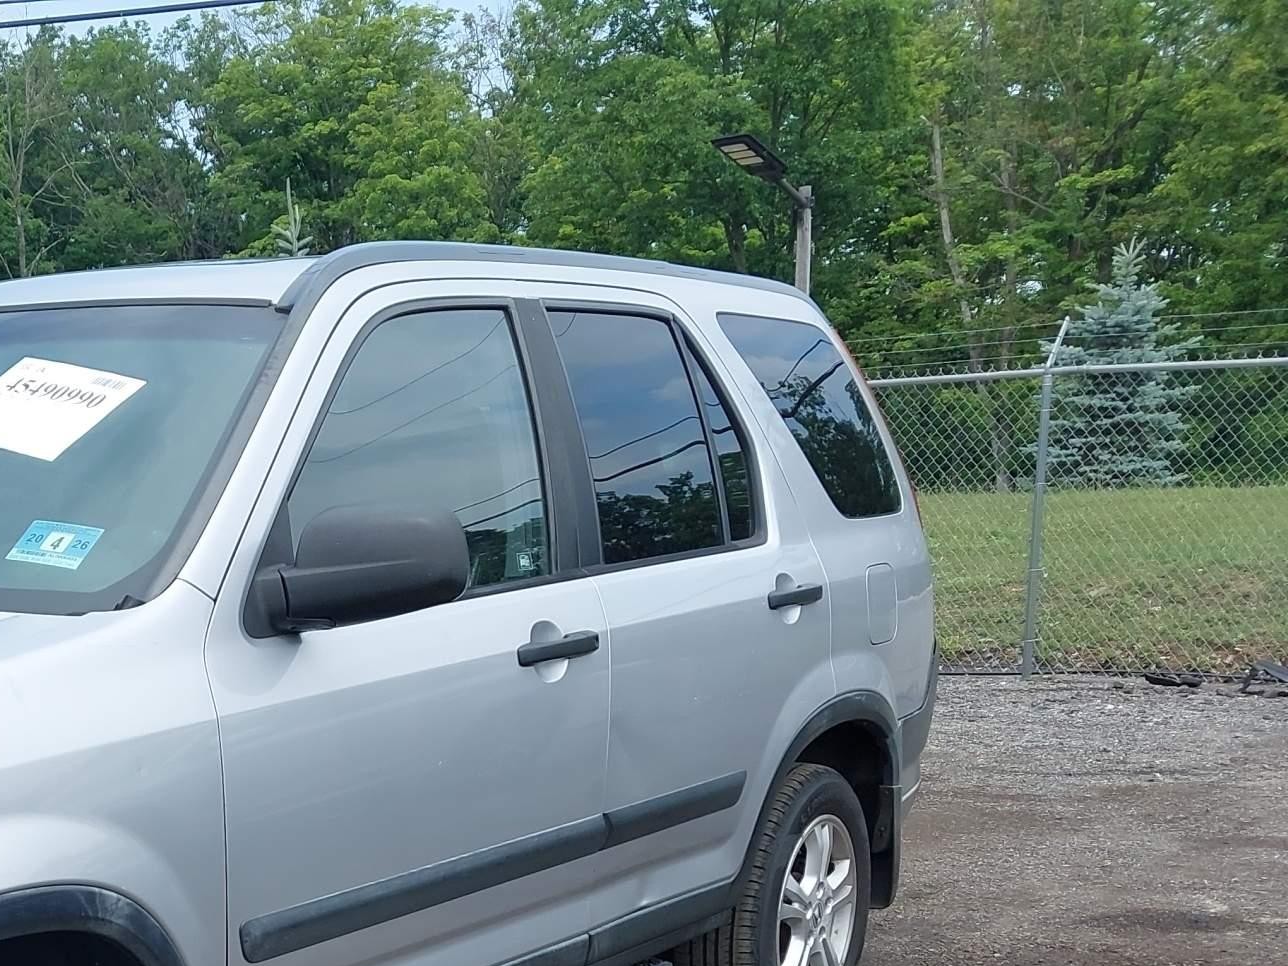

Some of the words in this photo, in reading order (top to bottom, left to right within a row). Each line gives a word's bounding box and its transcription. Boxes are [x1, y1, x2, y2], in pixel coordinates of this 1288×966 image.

[5, 378, 106, 408] 45490990
[26, 533, 44, 543] 20
[50, 536, 65, 550] 4
[72, 539, 90, 550] 26
